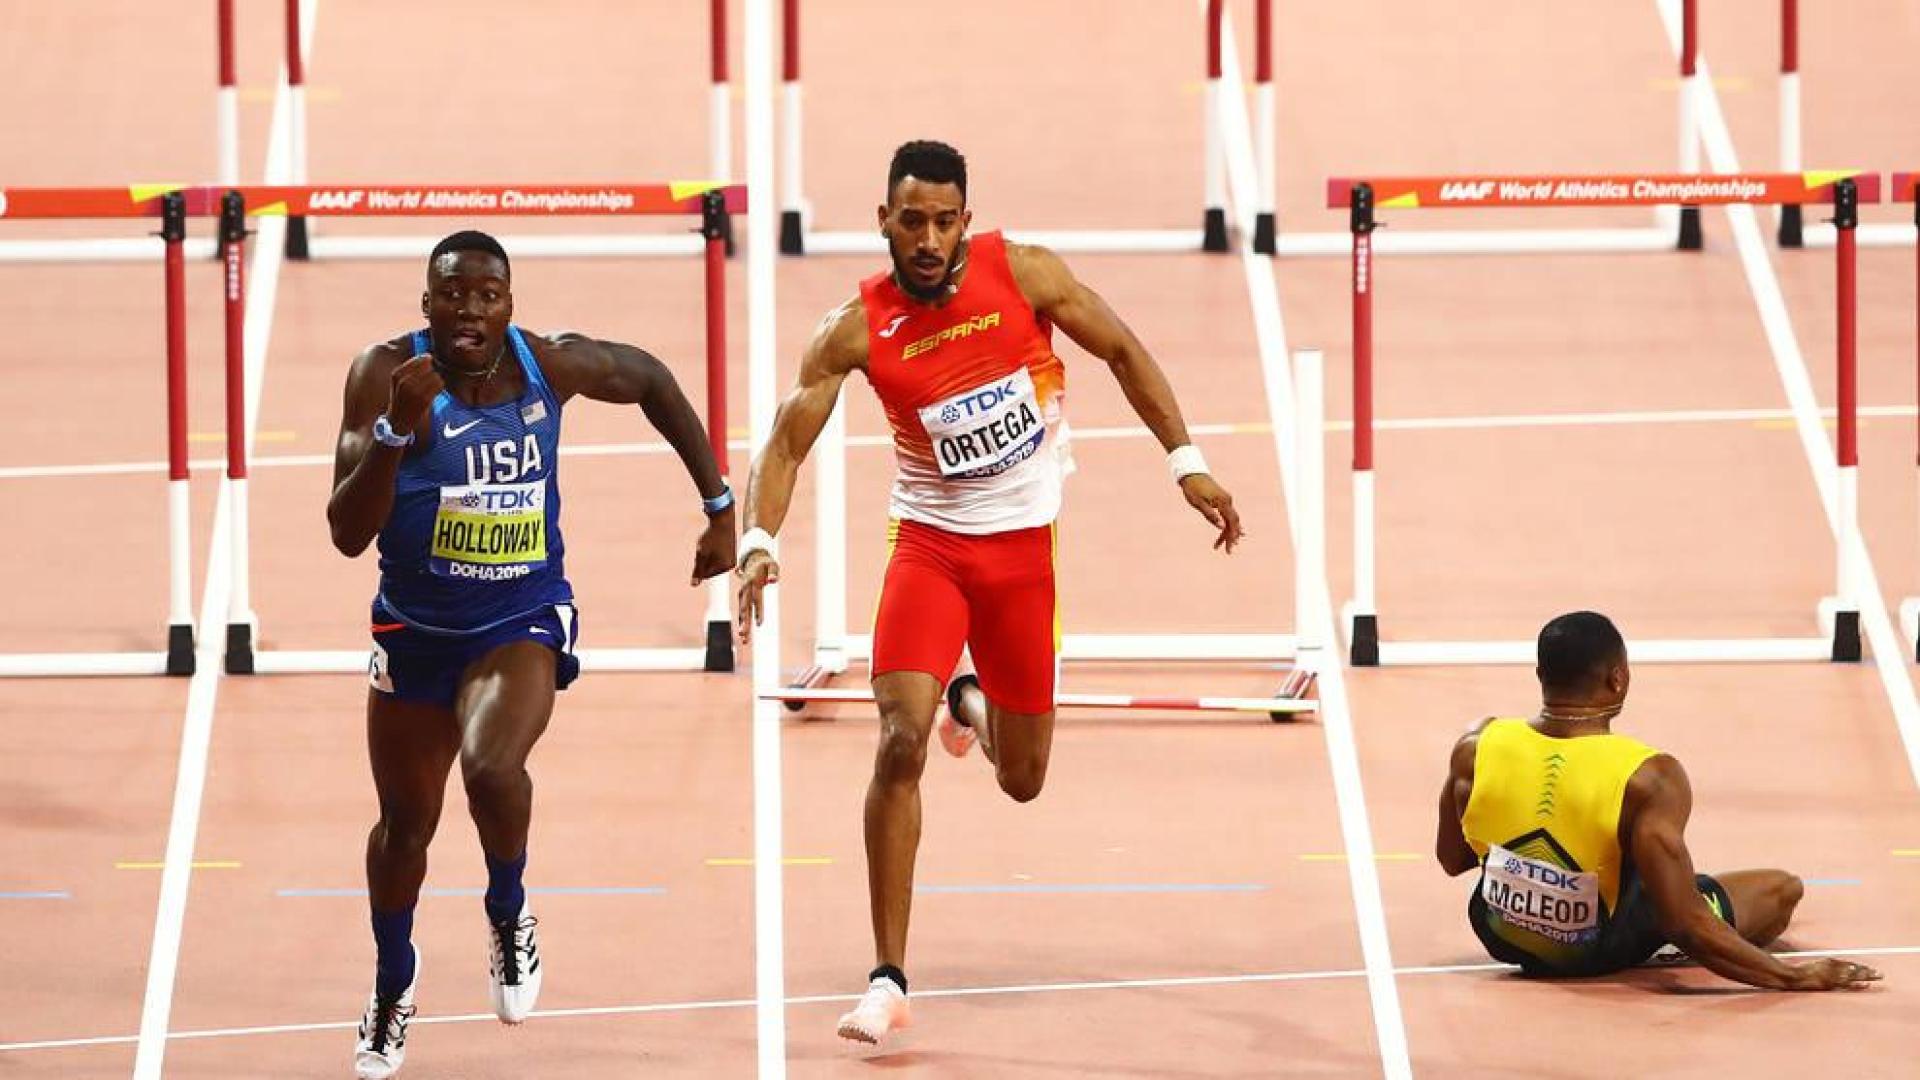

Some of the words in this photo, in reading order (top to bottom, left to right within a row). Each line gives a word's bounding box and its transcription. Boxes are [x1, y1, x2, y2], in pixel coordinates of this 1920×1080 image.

[309, 191, 365, 209] IAAF
[368, 191, 421, 209] World
[422, 189, 497, 209] Athletics
[501, 189, 634, 212] Championships
[1440, 182, 1496, 200] IAAF
[1499, 182, 1552, 200] World
[1553, 180, 1629, 200] Athletics
[1632, 179, 1766, 202] Championships
[902, 312, 1001, 361] ESPAÑA
[956, 380, 1017, 416] TDK
[940, 402, 1037, 467] ORTEGA
[465, 434, 542, 485] USA
[481, 489, 535, 509] TDK
[437, 519, 541, 555] HOLLOWAY
[450, 562, 530, 581] DOHA2019
[1522, 862, 1580, 891] TDK
[1488, 879, 1590, 924] McLEOD
